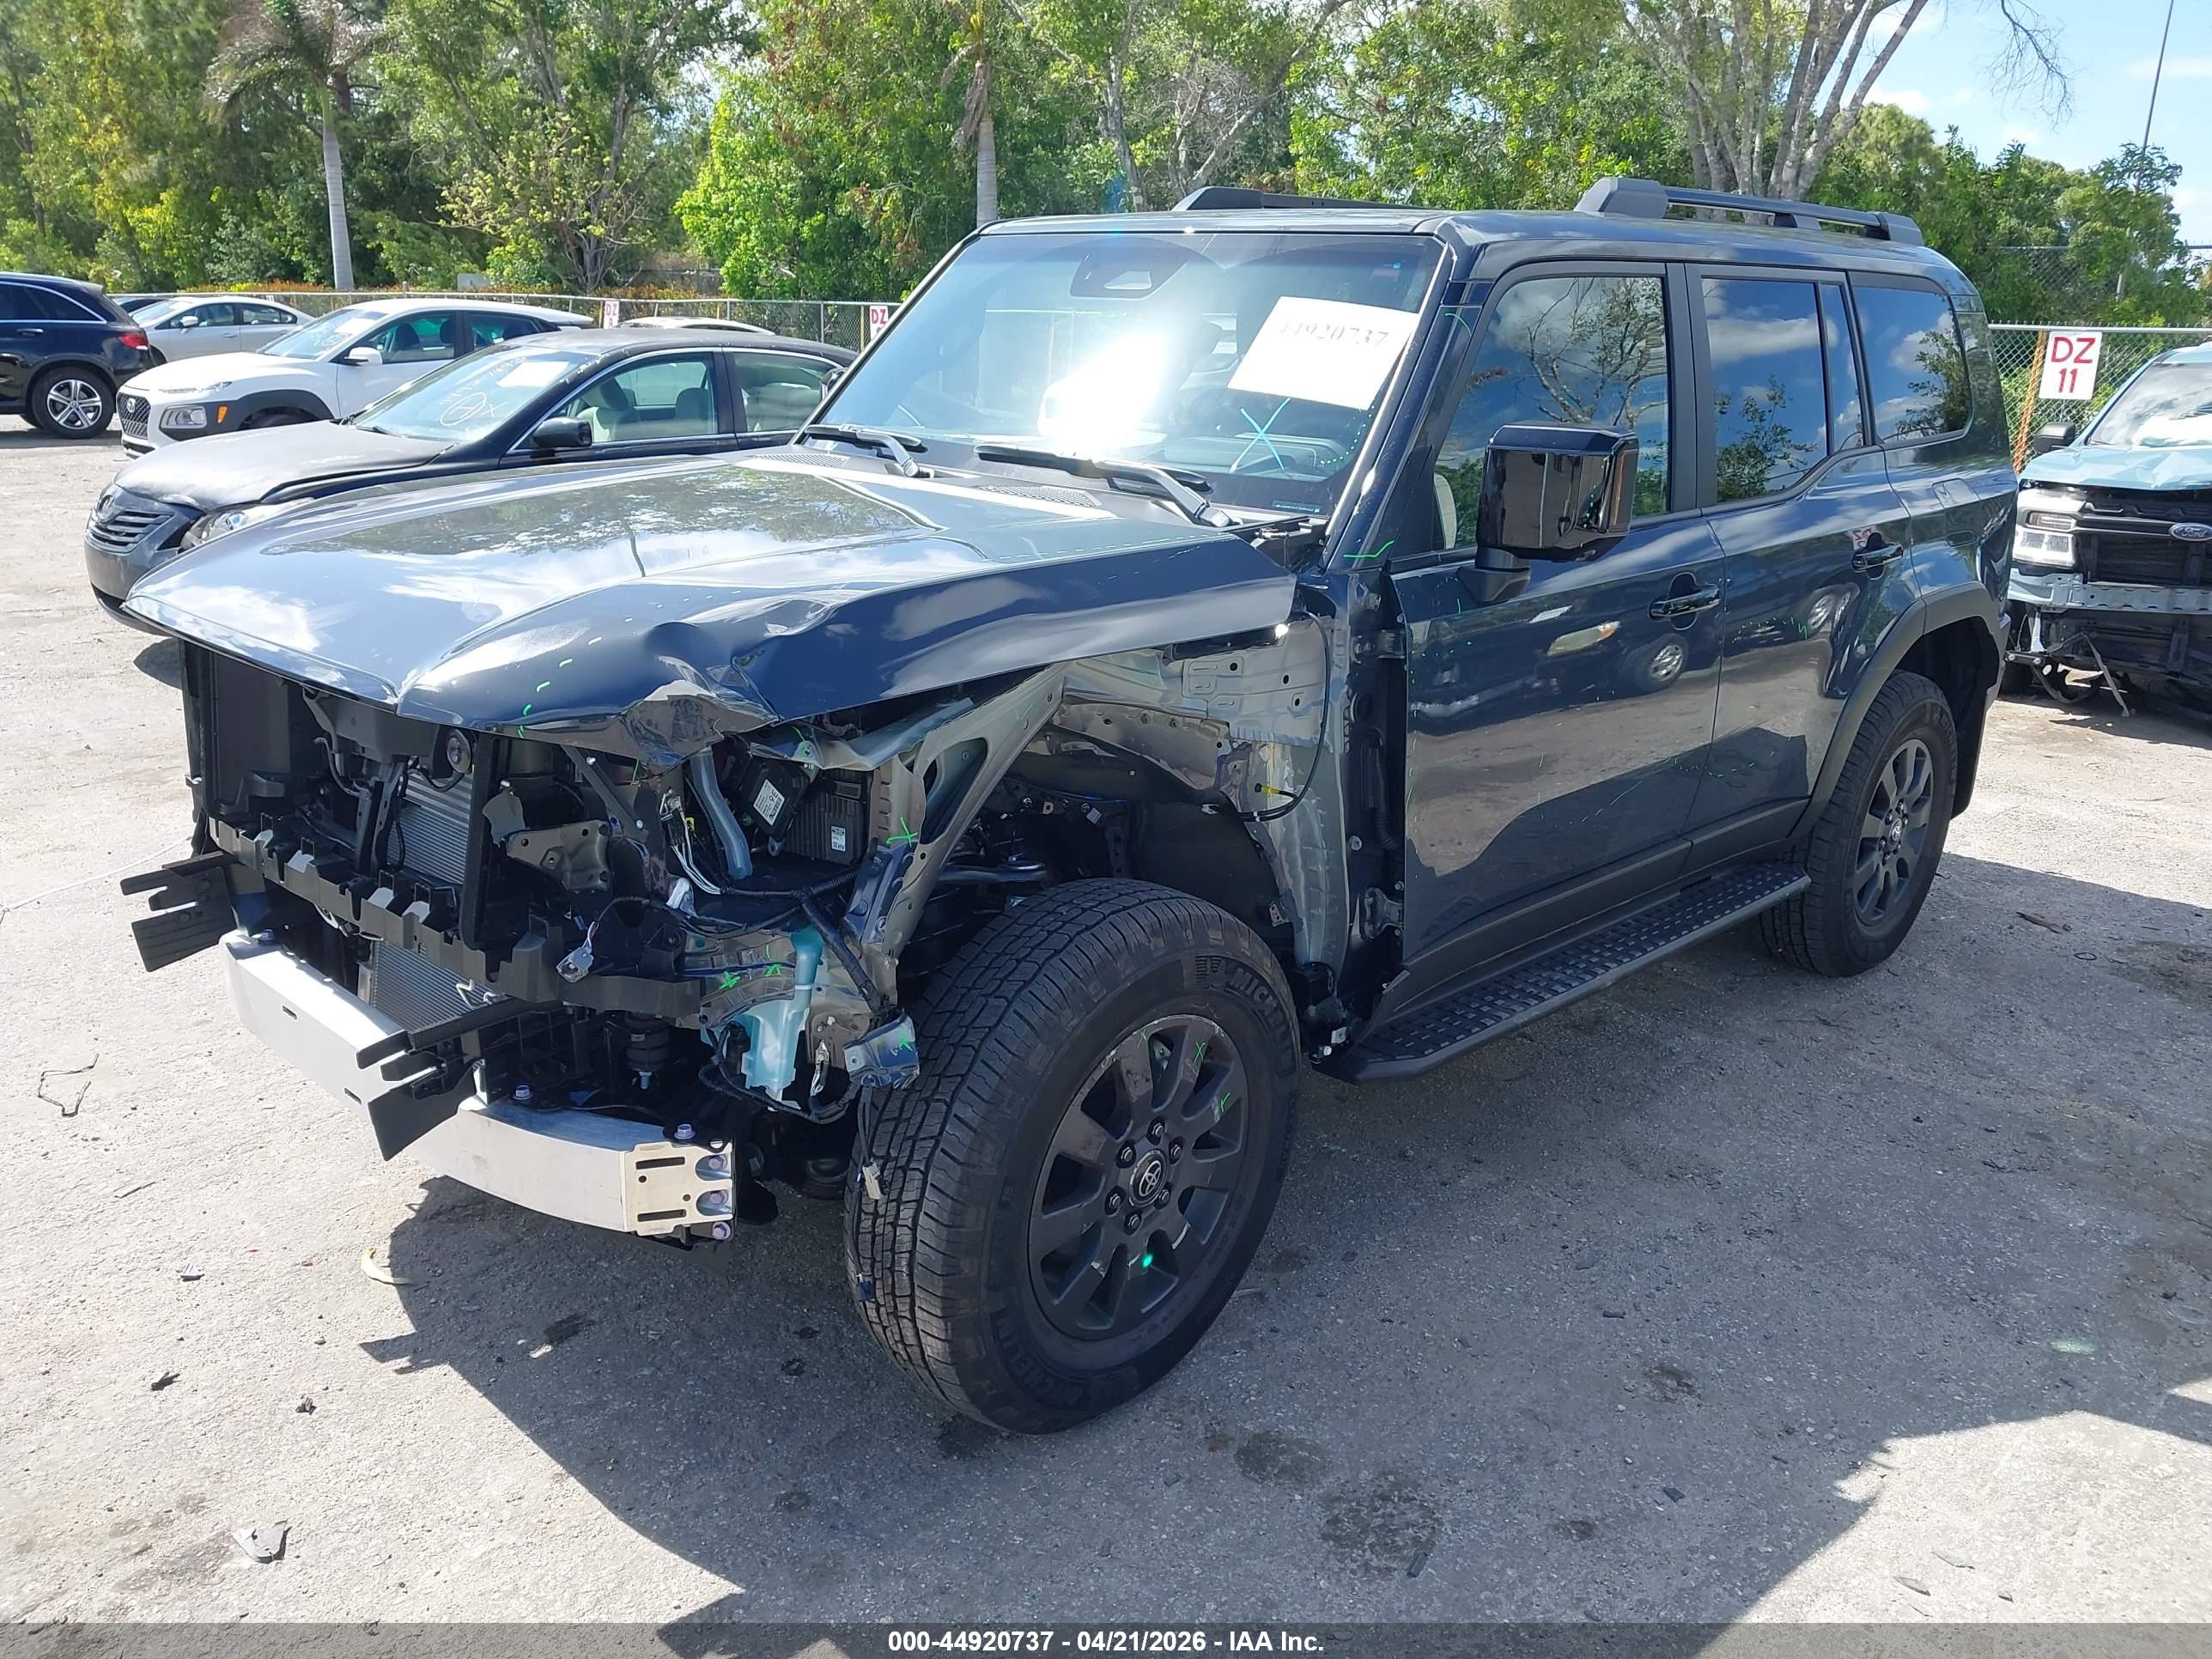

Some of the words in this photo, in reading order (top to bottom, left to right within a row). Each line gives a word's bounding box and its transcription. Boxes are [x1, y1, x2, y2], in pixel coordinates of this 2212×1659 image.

[605, 303, 617, 317] DZ
[871, 308, 887, 325] DZ
[2051, 336, 2096, 364] DZ
[2057, 368, 2078, 393] 11
